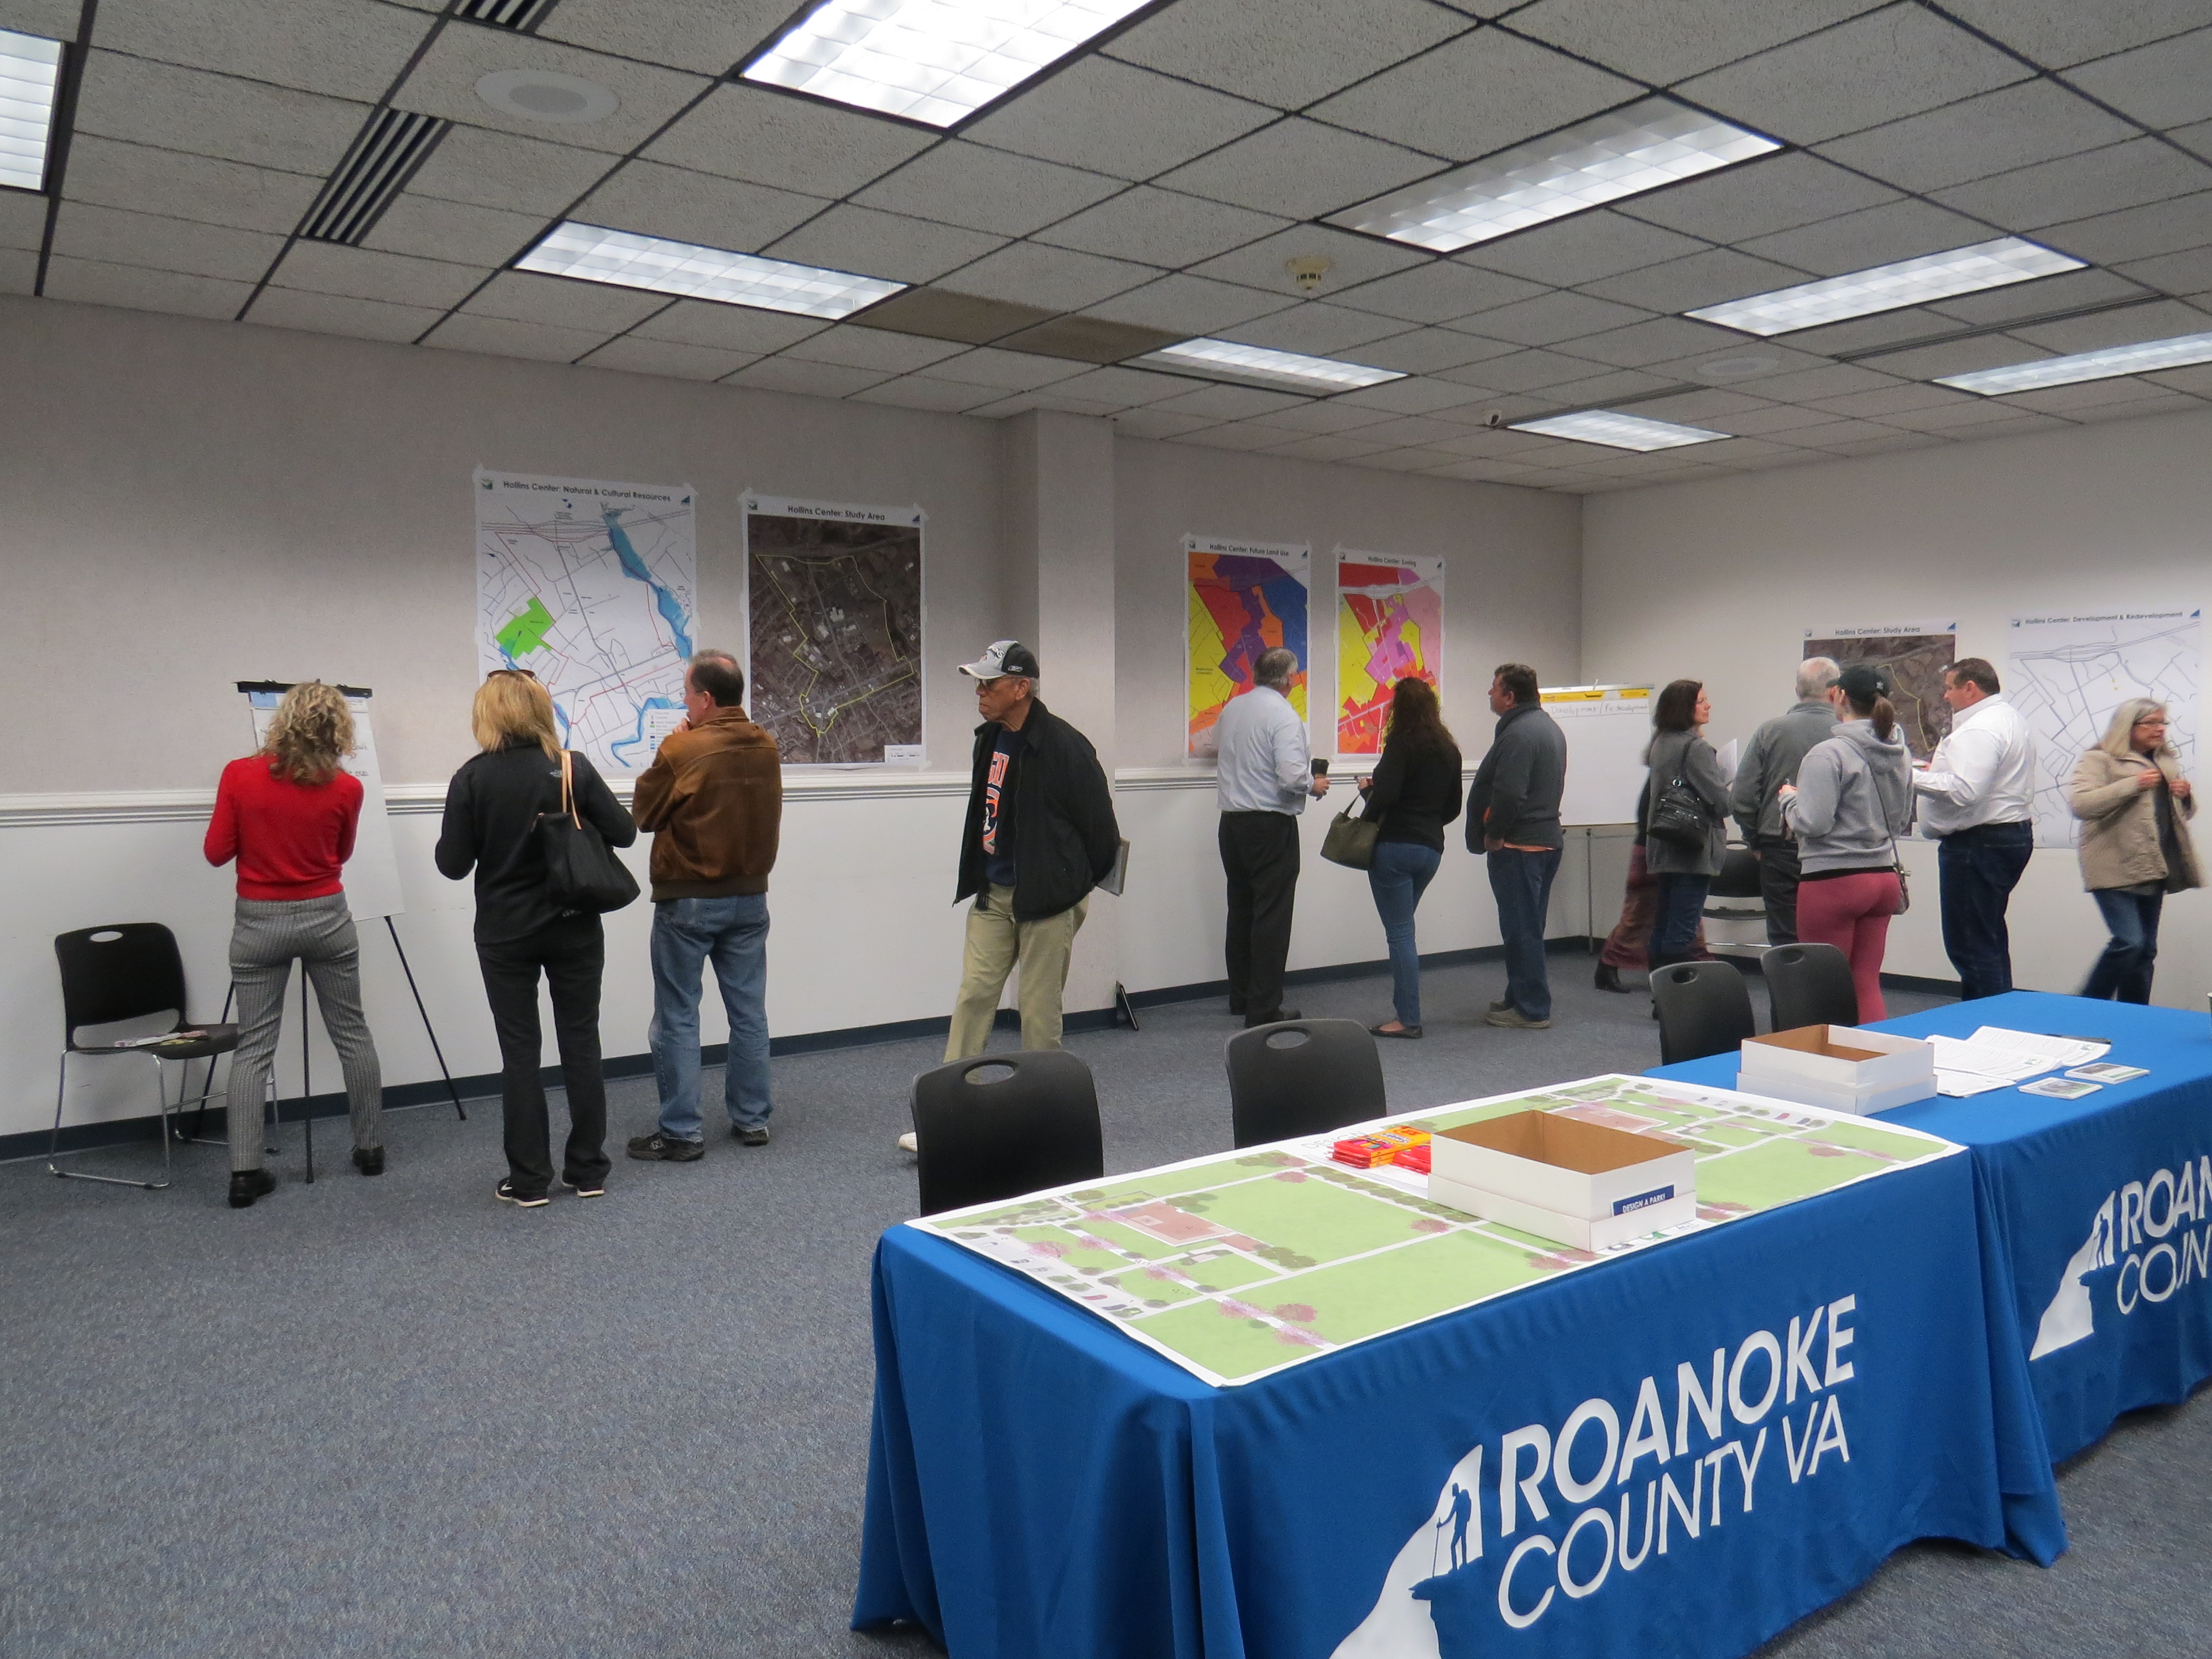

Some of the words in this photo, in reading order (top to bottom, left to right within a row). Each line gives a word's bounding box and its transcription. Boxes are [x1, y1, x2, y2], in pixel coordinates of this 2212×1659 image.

[503, 481, 529, 490] Hollins
[531, 483, 561, 493] Center:
[563, 486, 592, 495] Natural
[602, 489, 631, 498] Cultural
[633, 492, 671, 502] Resources
[787, 505, 813, 515] Hollins
[815, 508, 843, 518] Center:
[845, 510, 865, 520] Study
[867, 512, 885, 521] Area
[1228, 545, 1248, 553] Center:
[1401, 559, 1417, 567] Zoning
[2073, 614, 2118, 622] Development
[2126, 612, 2183, 620] Redevelopment
[1883, 627, 1902, 635] Study
[1622, 1200, 1643, 1213] DESIGN
[1650, 1193, 1666, 1204] PARK!
[1499, 1293, 1856, 1538] ROANOKE
[1498, 1427, 1767, 1629] COUNTY
[1782, 1394, 1850, 1484] VA
